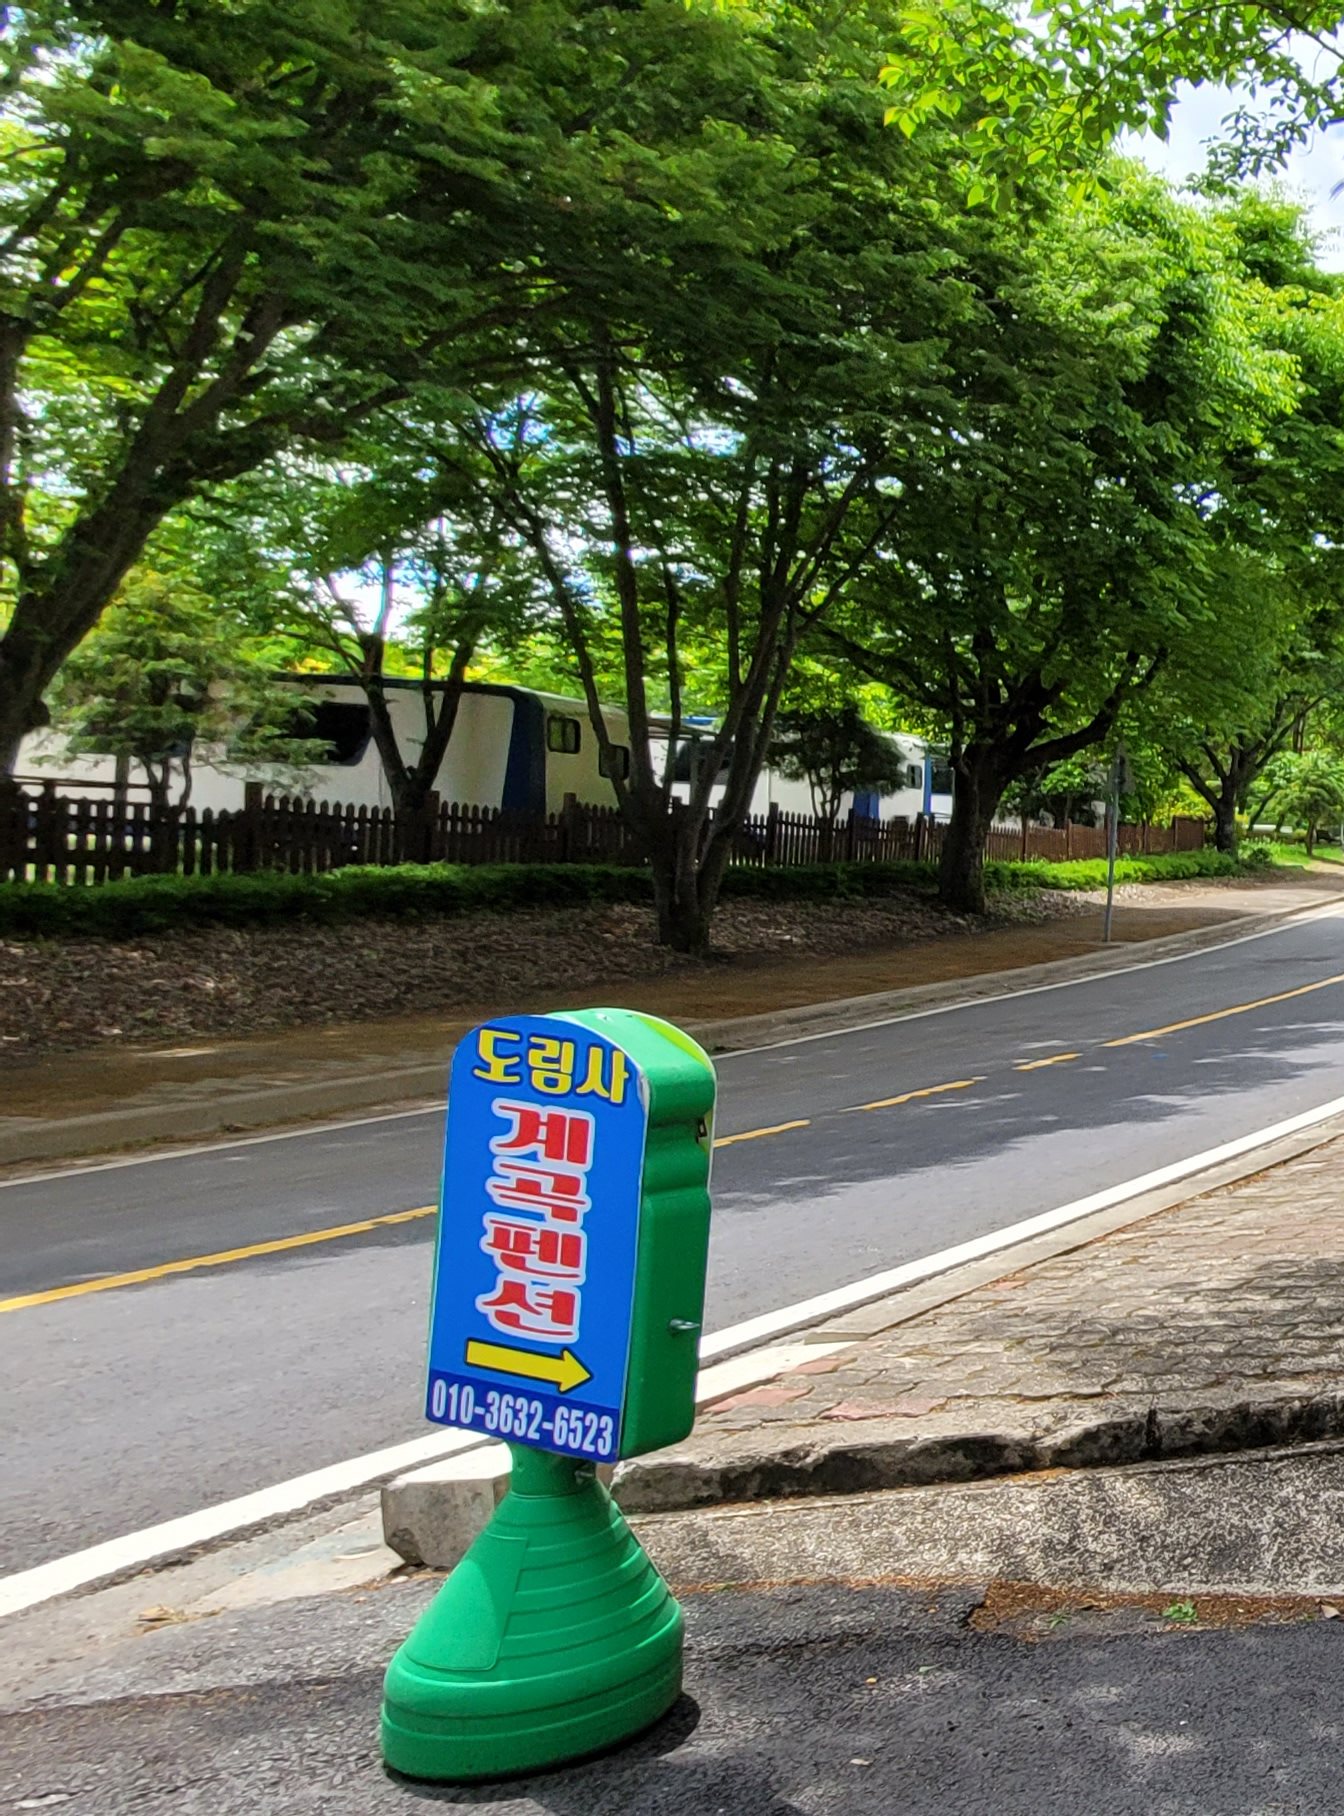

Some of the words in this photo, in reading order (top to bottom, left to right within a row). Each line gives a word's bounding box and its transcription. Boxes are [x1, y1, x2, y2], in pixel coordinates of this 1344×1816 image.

[474, 1028, 629, 1104] 도림사
[478, 1101, 593, 1341] 계곡펜션
[432, 1379, 614, 1457] 010-3632-6523
